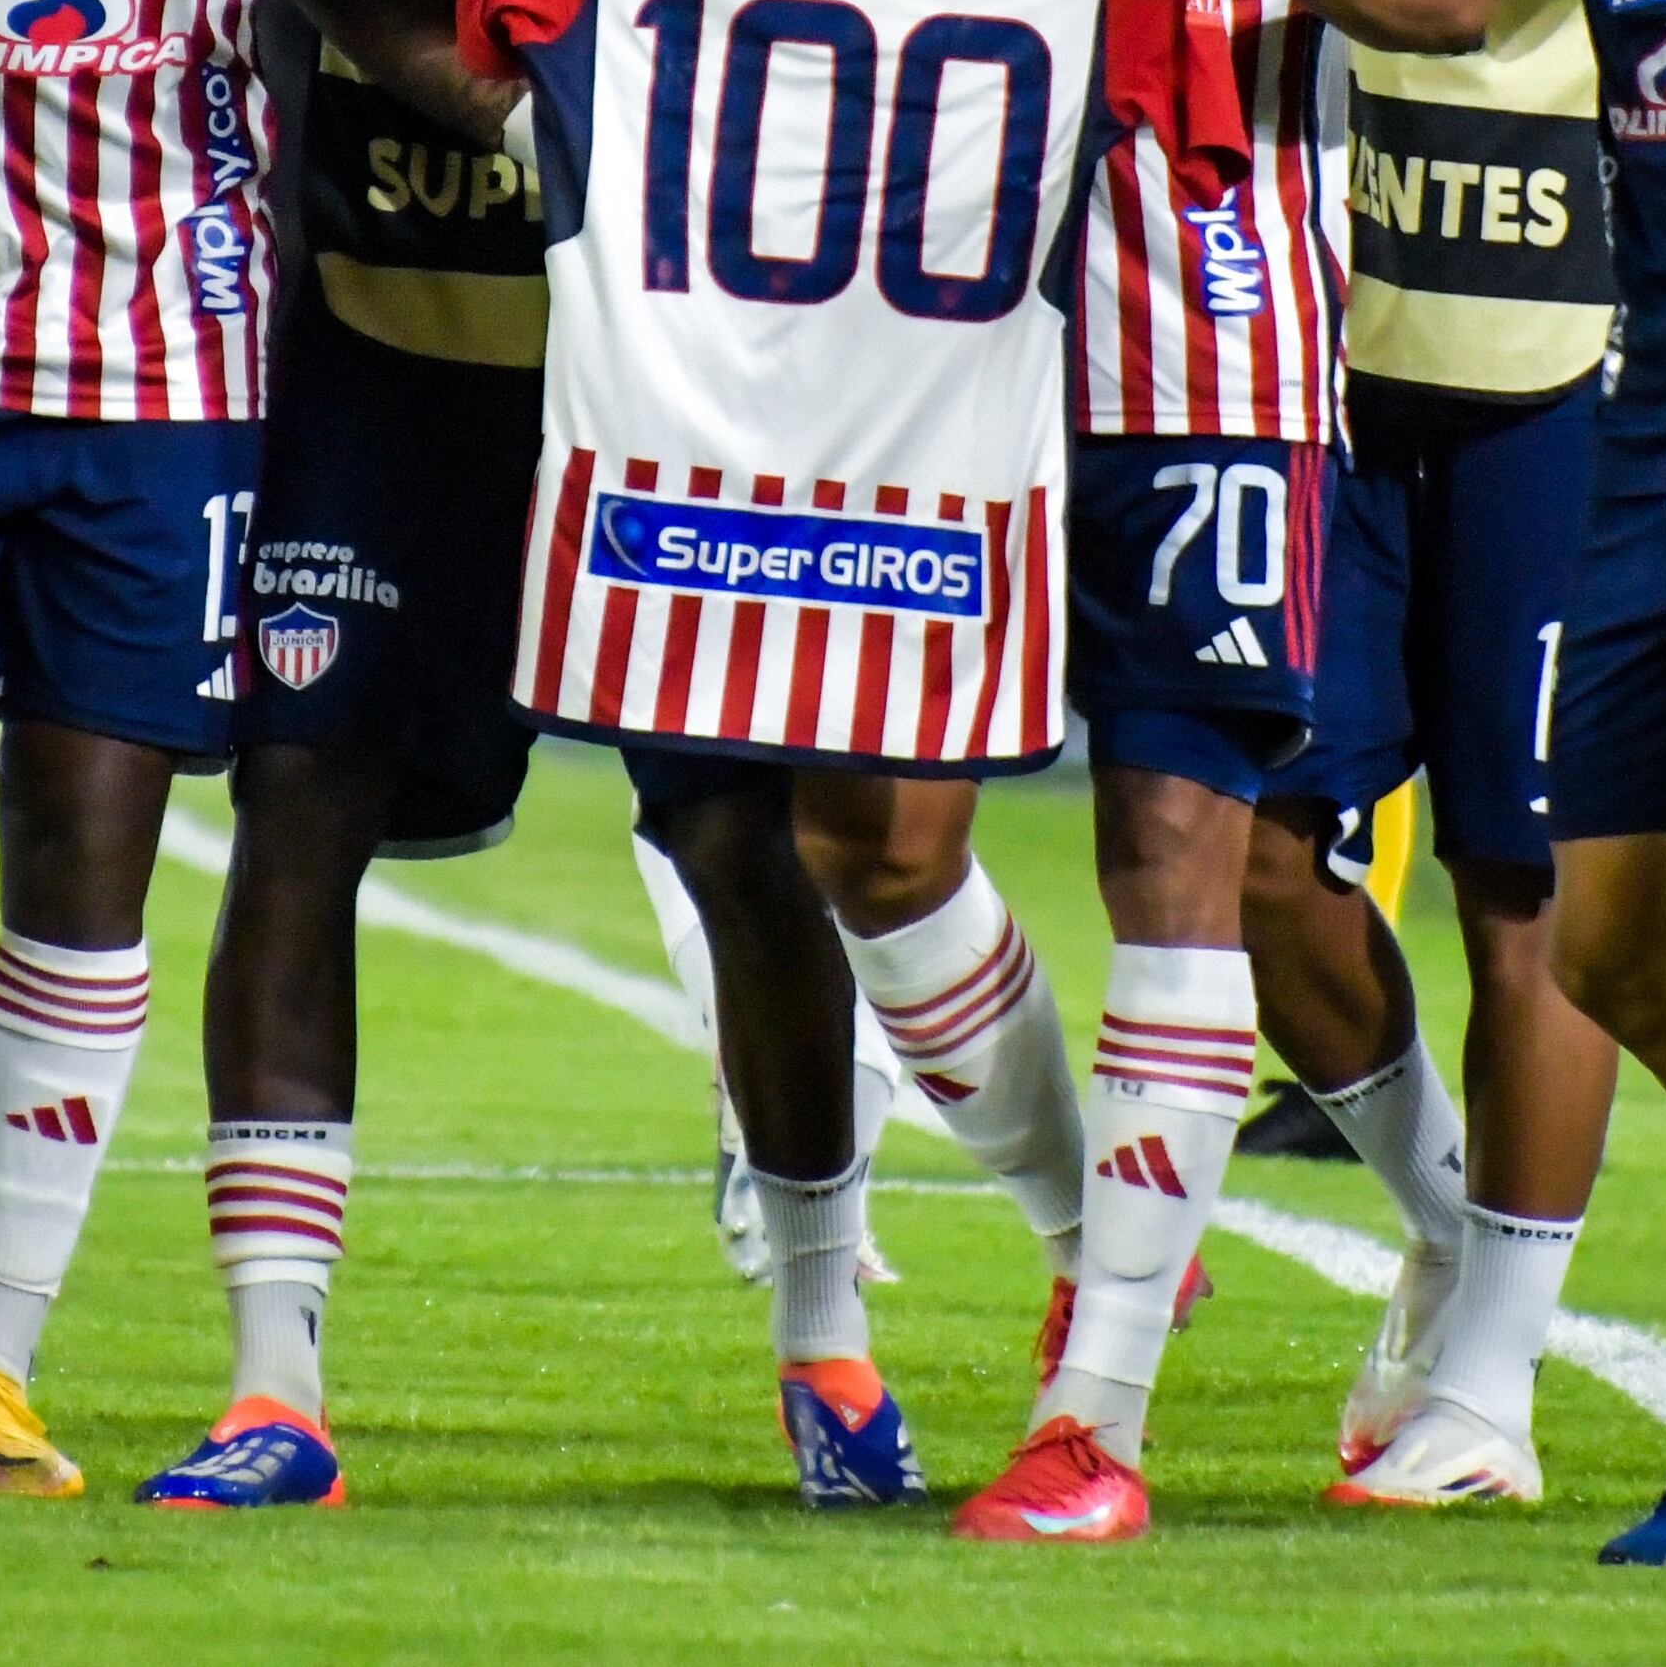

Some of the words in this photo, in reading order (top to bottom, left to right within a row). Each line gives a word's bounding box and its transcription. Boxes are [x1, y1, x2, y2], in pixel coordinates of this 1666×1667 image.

[258, 540, 355, 564] expreso
[1148, 463, 1288, 608] 70
[253, 562, 399, 611] brasilia
[272, 635, 325, 648] JUNIOR
